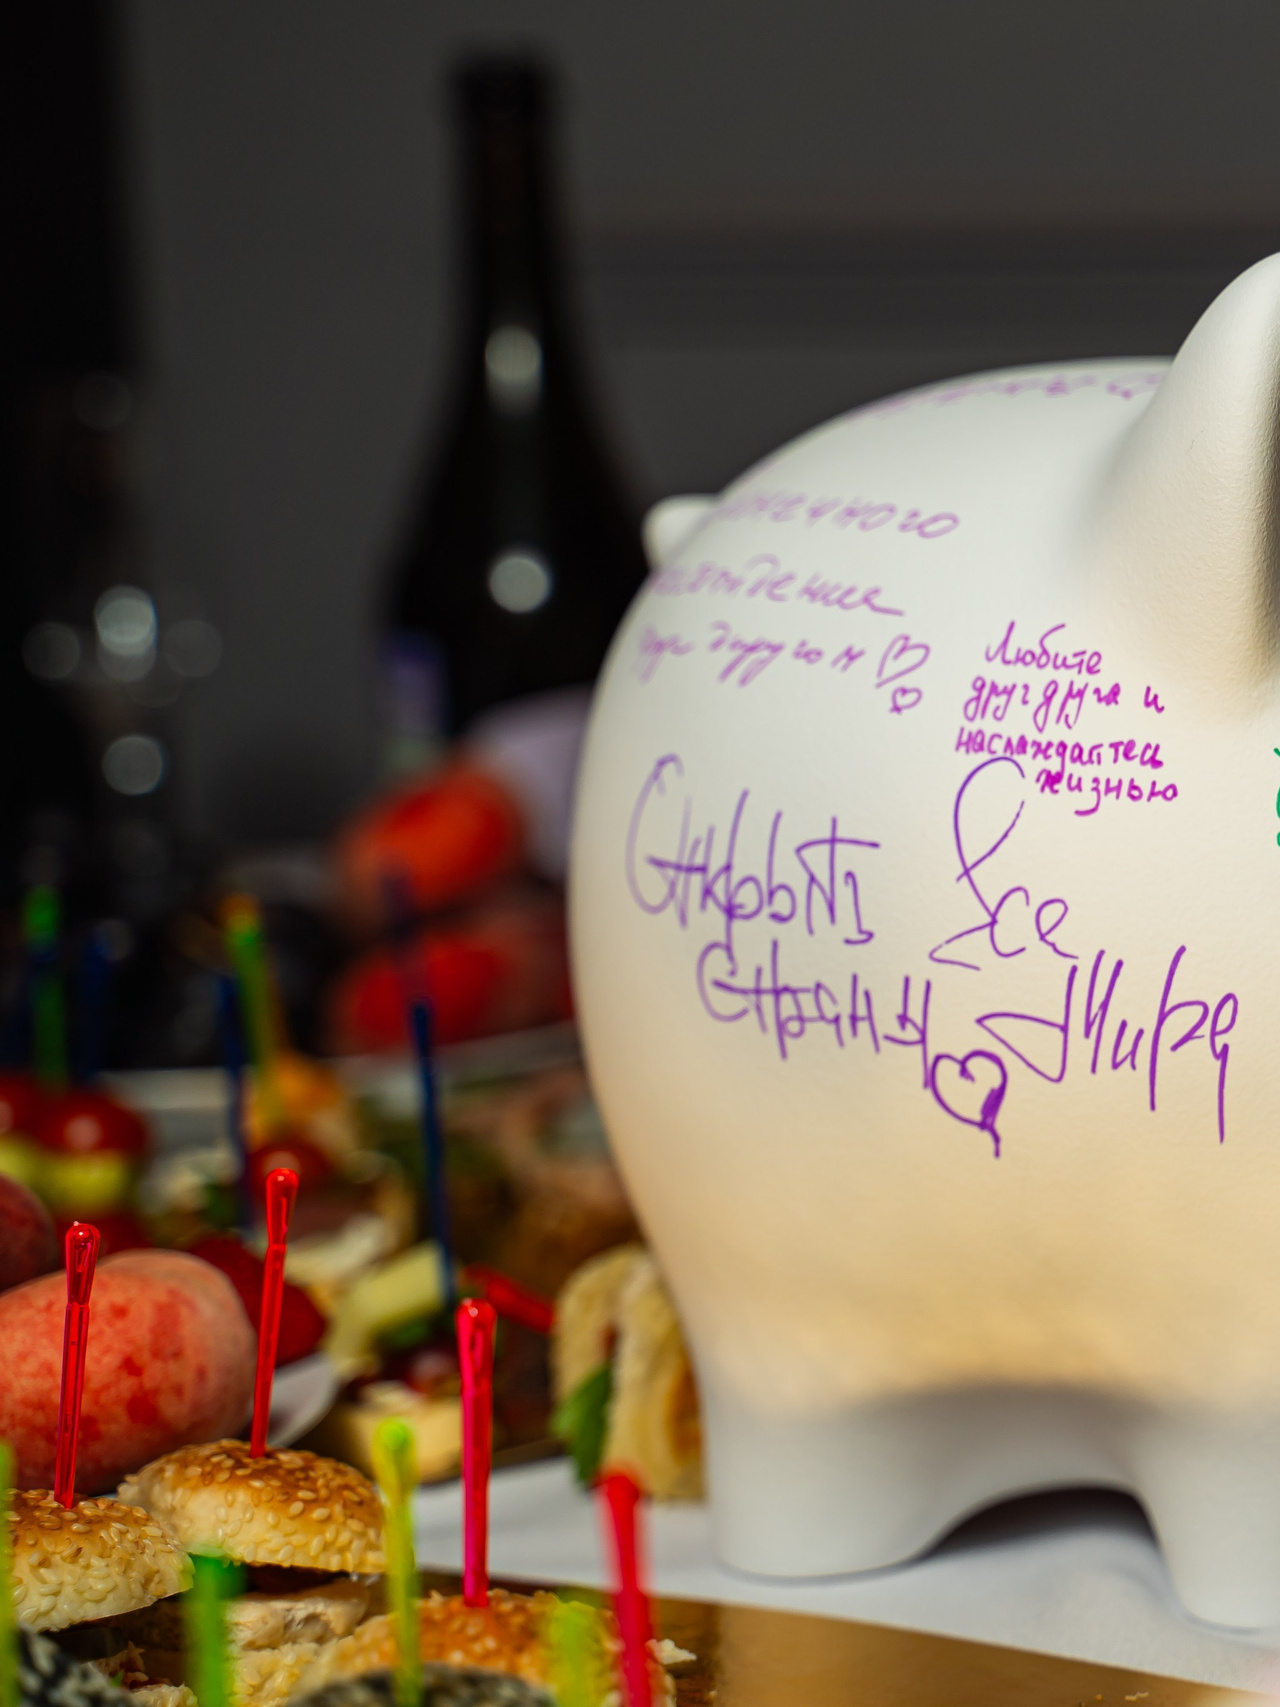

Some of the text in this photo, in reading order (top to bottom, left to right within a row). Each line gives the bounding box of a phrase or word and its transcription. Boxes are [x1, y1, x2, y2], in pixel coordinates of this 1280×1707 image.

[985, 620, 1102, 675] Любите
[963, 675, 1165, 734] друг друга и
[1035, 767, 1178, 816] жизнью
